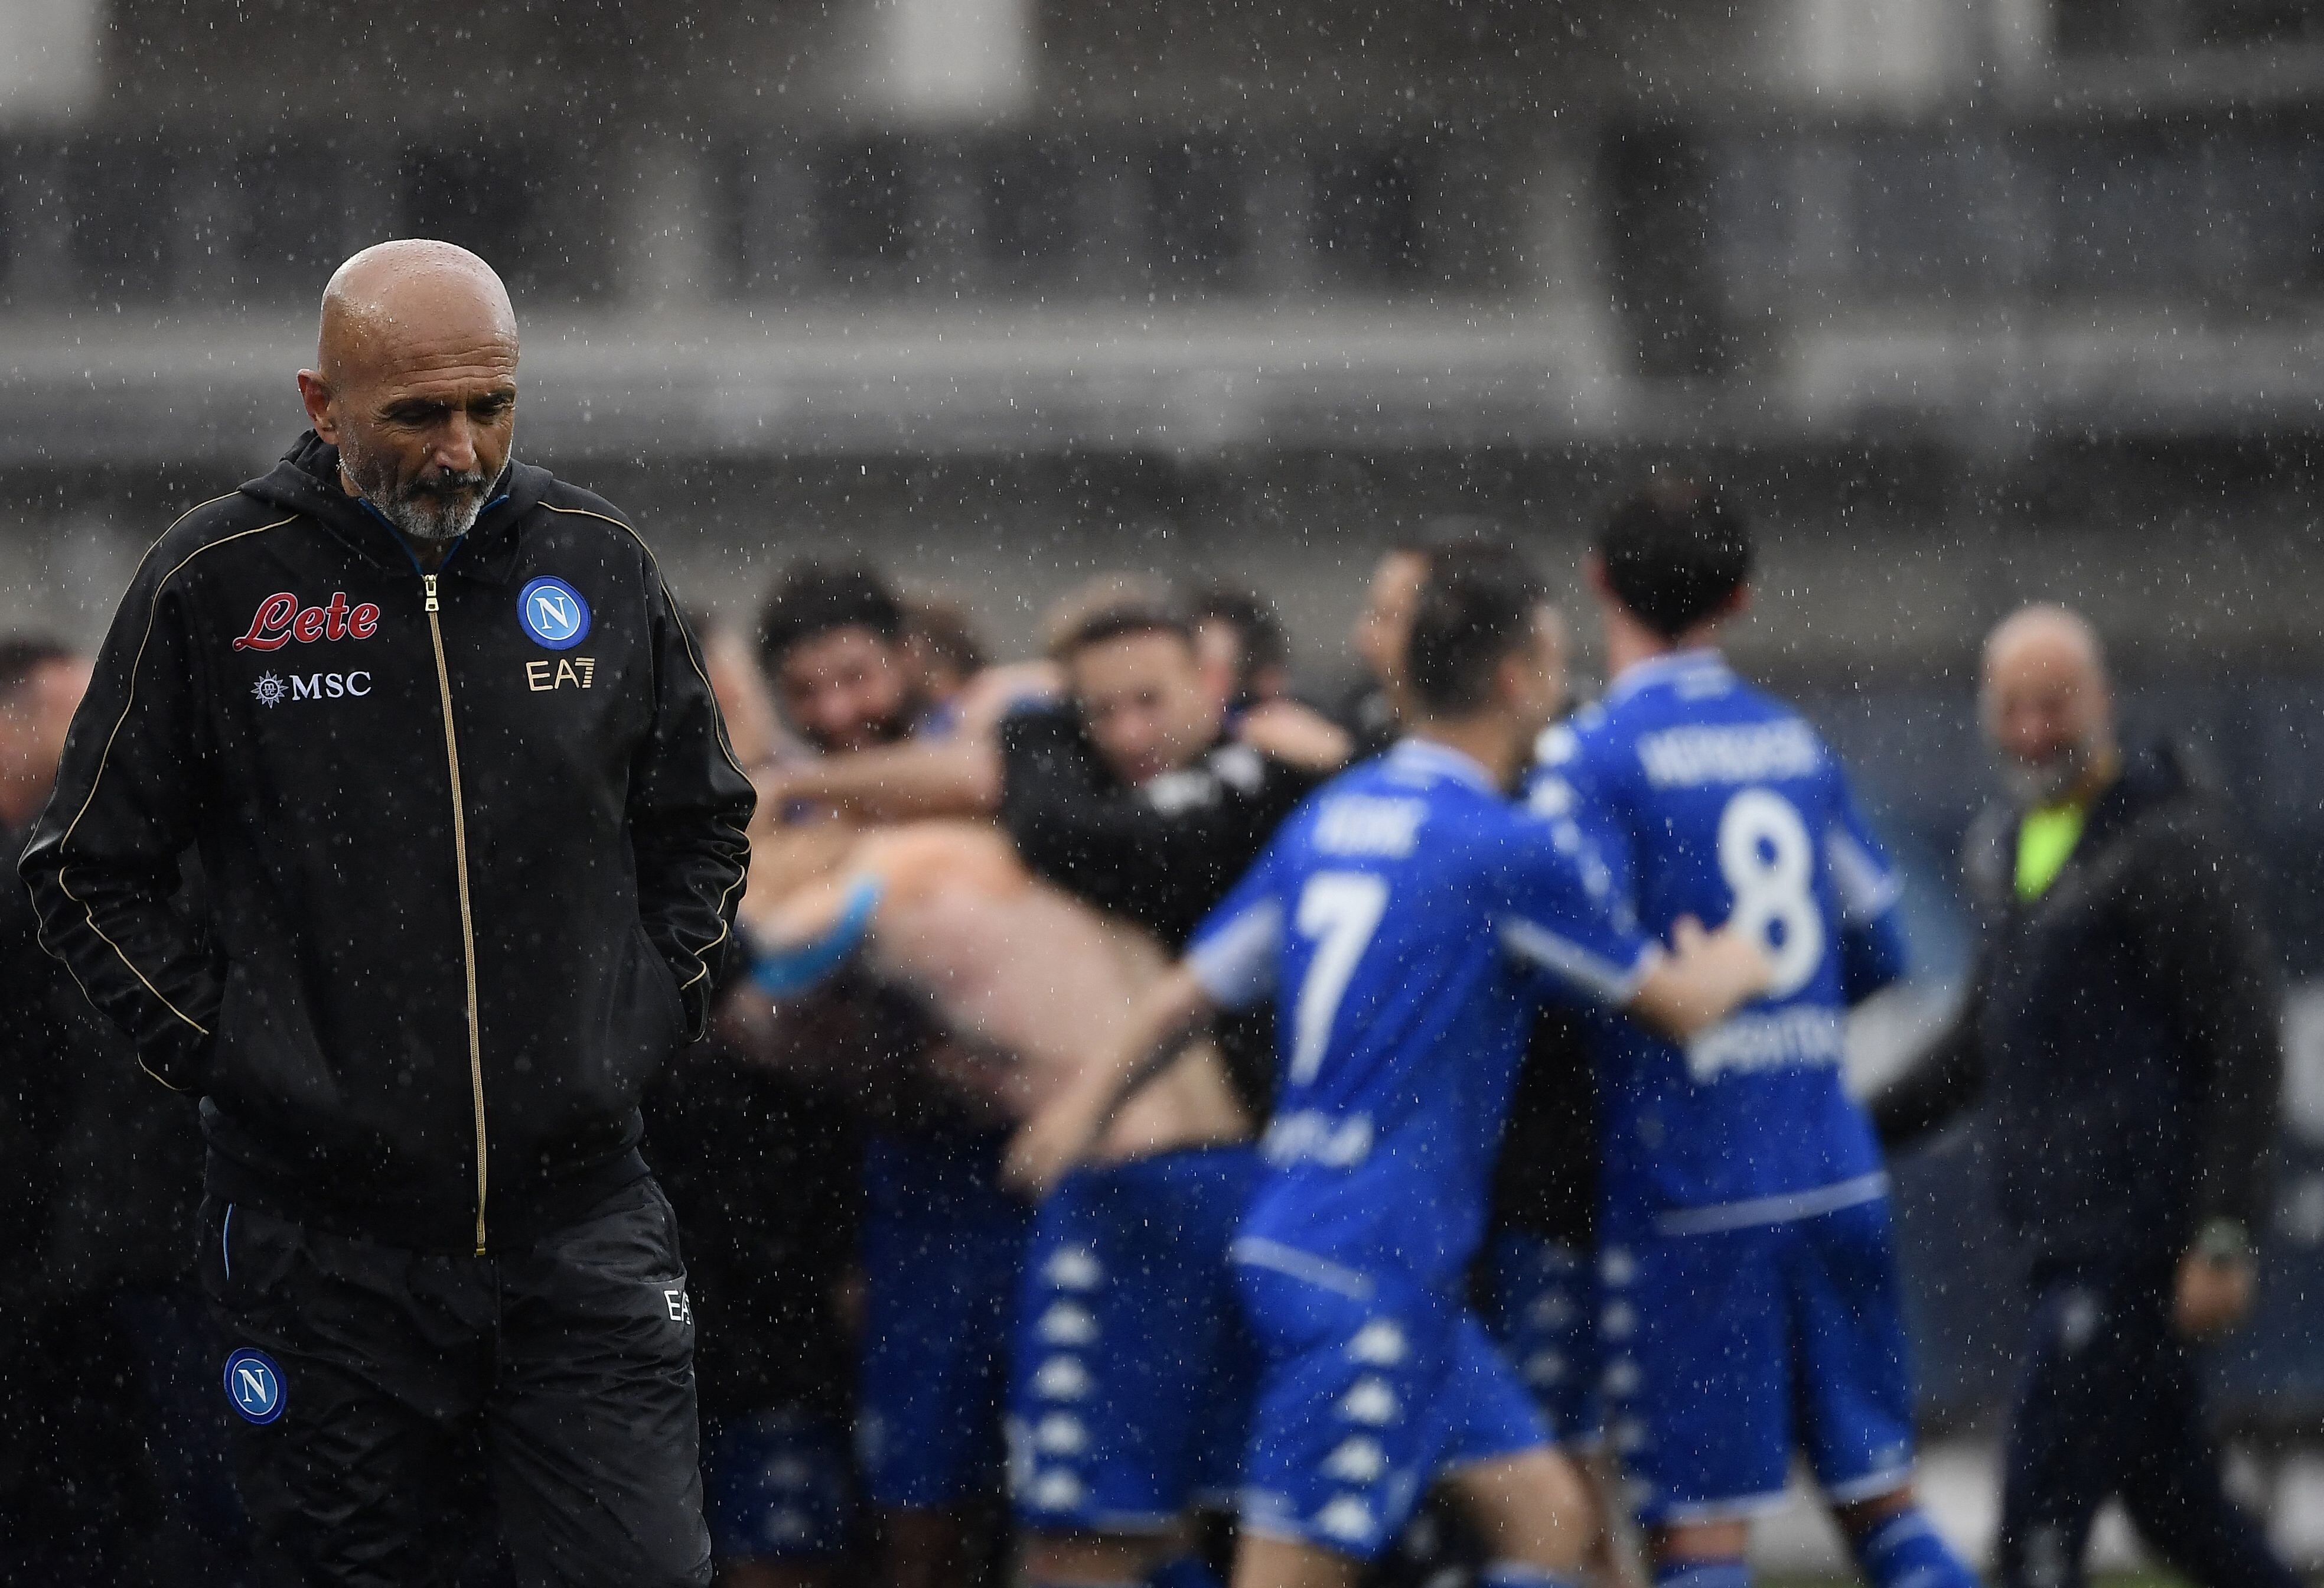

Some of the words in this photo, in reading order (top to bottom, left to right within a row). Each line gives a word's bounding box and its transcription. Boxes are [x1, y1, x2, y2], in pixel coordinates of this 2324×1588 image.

[233, 591, 380, 652] Lete
[534, 597, 569, 629] N
[289, 671, 371, 701] MSC
[526, 657, 595, 691] EA7
[1719, 789, 1824, 1000] 8
[1292, 872, 1389, 1086] 7
[238, 1369, 267, 1403] N
